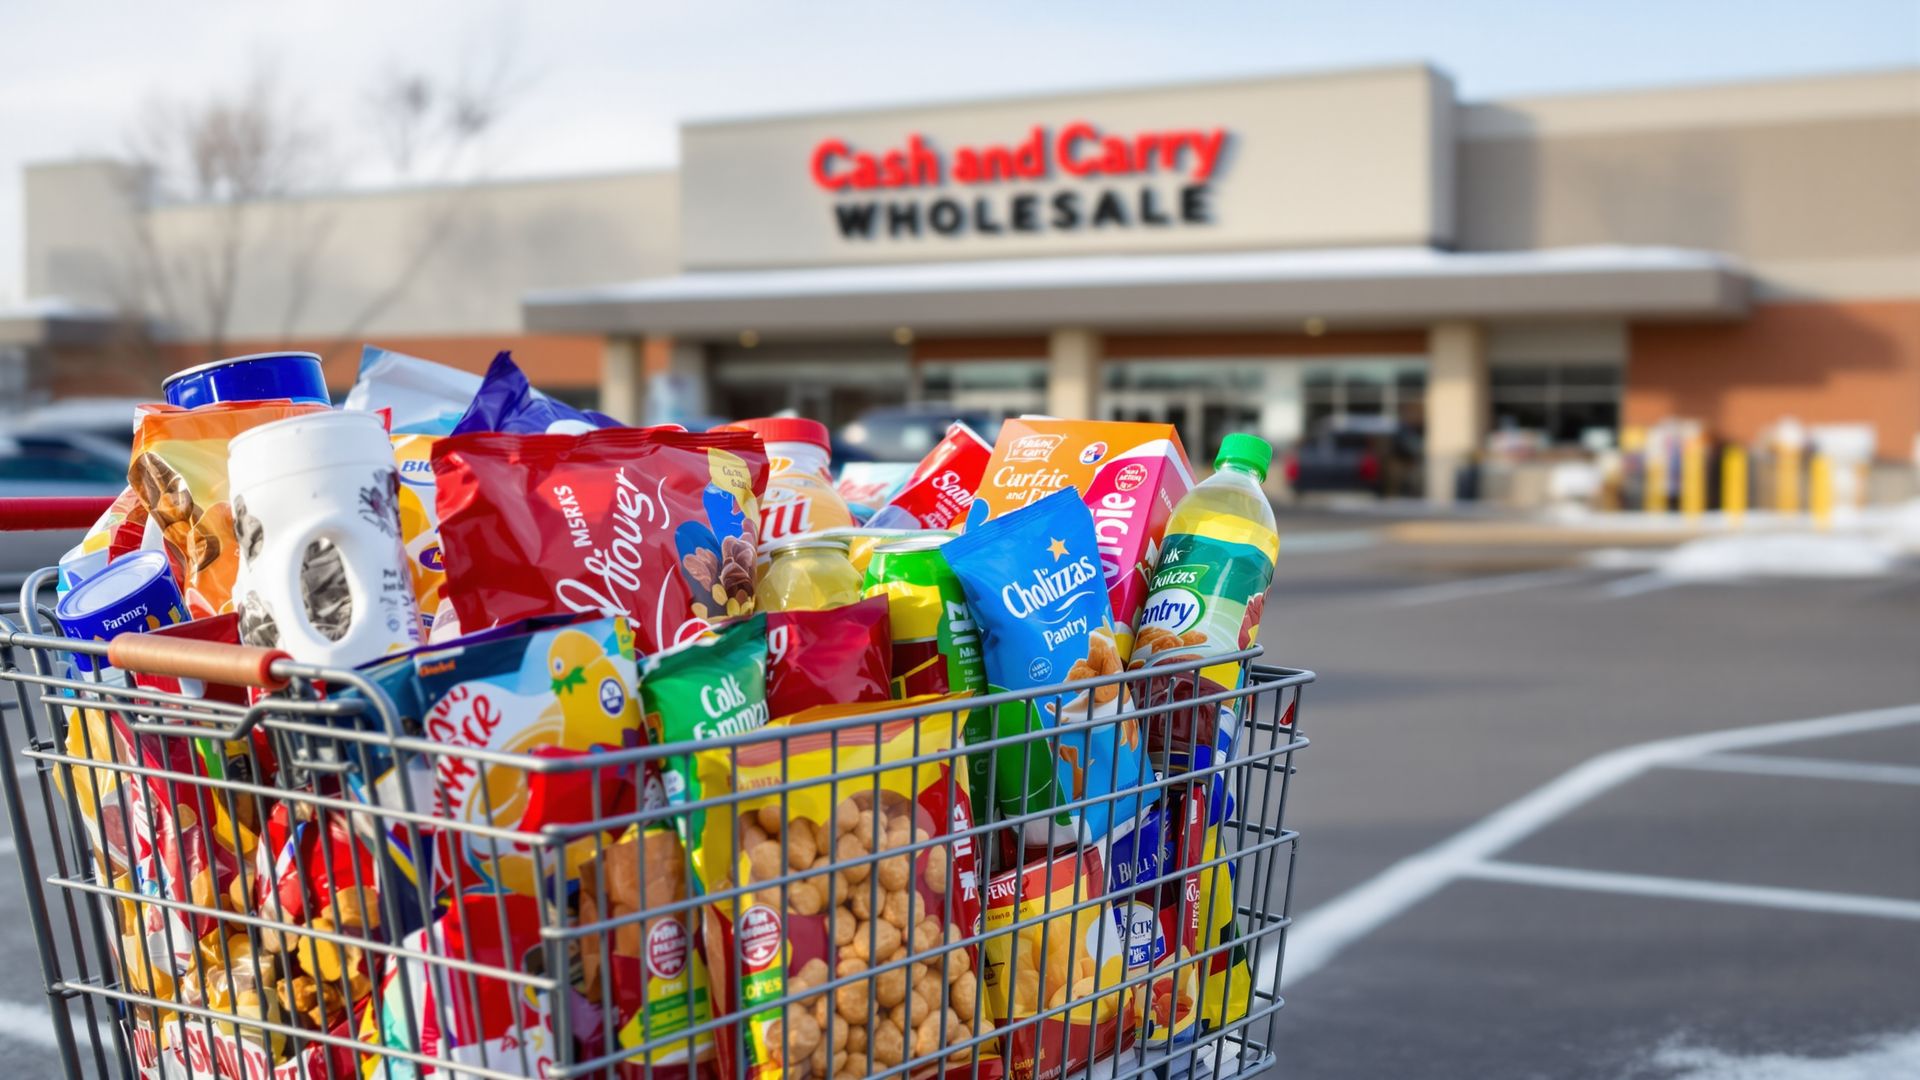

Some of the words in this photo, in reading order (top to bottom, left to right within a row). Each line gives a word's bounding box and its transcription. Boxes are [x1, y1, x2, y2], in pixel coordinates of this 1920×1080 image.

[810, 134, 941, 192] Cash
[952, 125, 1047, 184] and
[1056, 120, 1228, 185] Carry
[834, 186, 1212, 240] WHOLESALE
[1006, 489, 1027, 501] and
[1140, 599, 1195, 629] antry
[1042, 615, 1088, 652] Pantry
